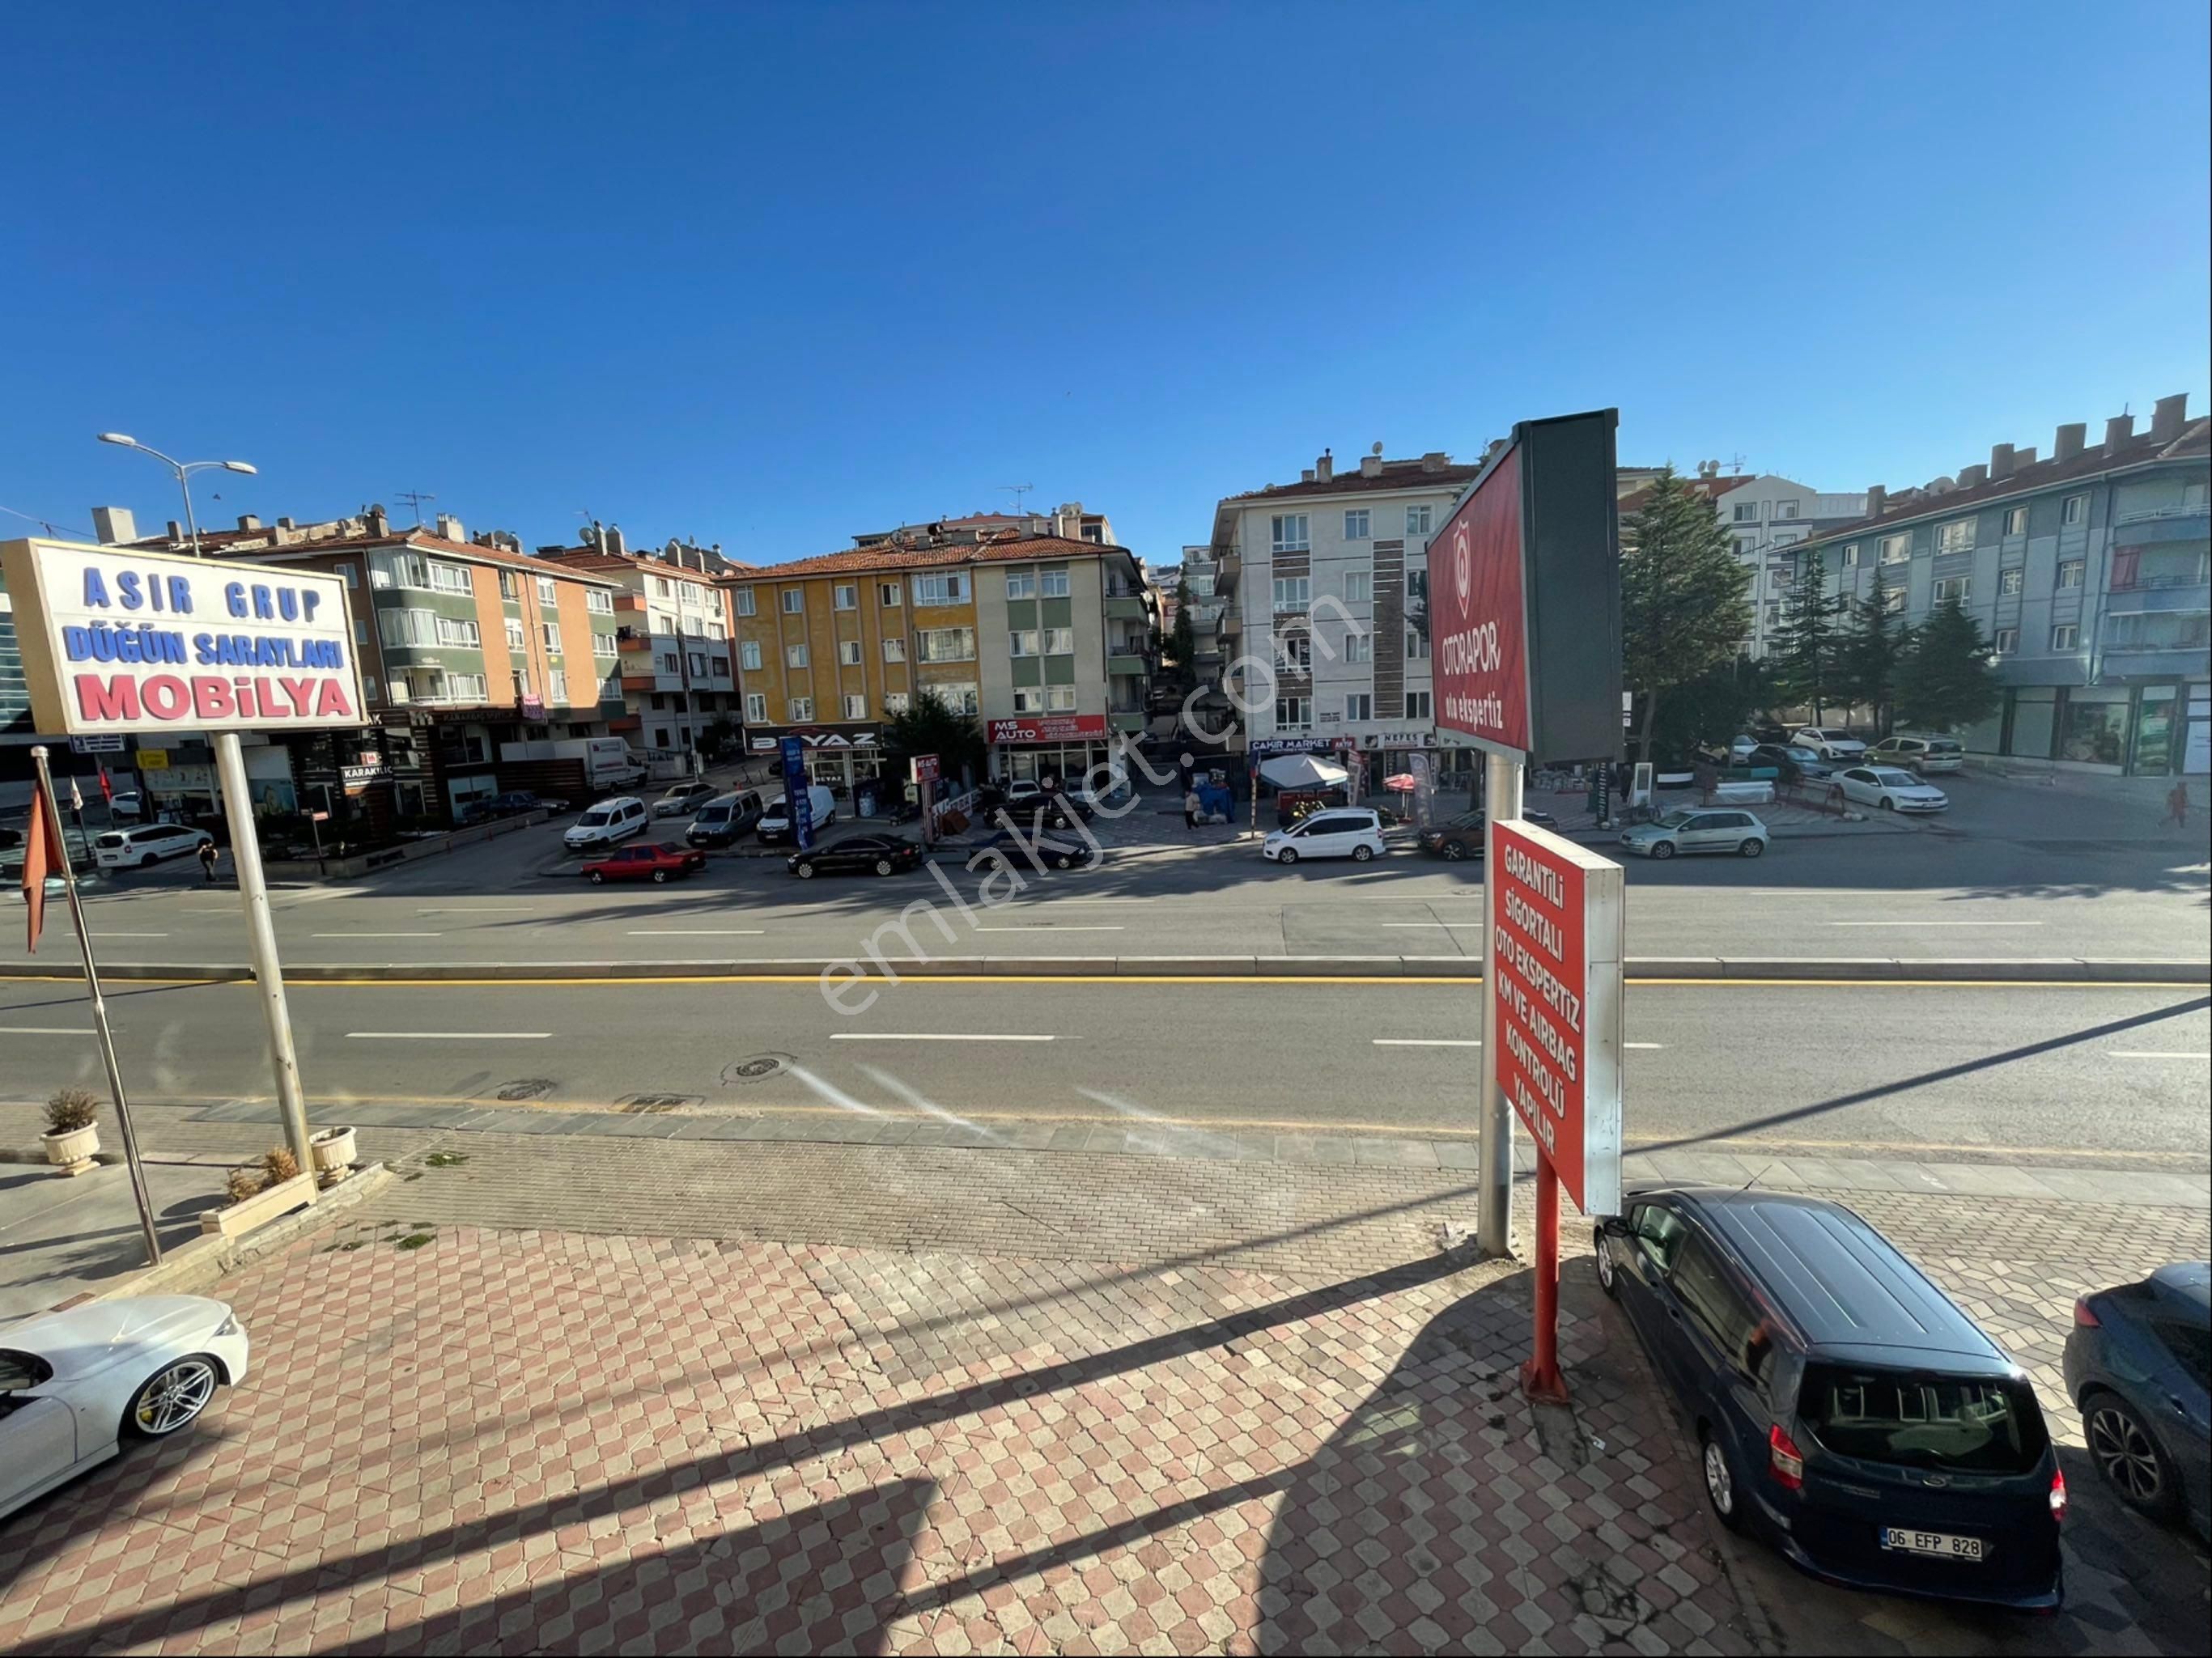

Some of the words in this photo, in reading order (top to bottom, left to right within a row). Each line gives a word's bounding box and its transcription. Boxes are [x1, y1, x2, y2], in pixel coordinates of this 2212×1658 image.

[83, 567, 193, 613] ASIR
[225, 581, 321, 622] GRUP
[62, 620, 187, 664] DÜĞÜN
[193, 632, 345, 668] SARAYLARI
[1442, 621, 1501, 676] OTORAPOR
[995, 721, 1018, 730] MS
[1458, 691, 1503, 731] ekspertiz
[752, 732, 877, 749] BYAZ
[996, 730, 1037, 740] AUTO
[1286, 739, 1331, 748] MARKET
[1496, 925, 1514, 963] OTO
[1498, 969, 1512, 1006] KM
[1514, 984, 1527, 1024] VE
[1530, 1004, 1576, 1082] AIRBAG
[1506, 1019, 1564, 1118] KONTROLÜ
[1514, 1071, 1555, 1156] YAPILIR
[1888, 1530, 1905, 1545] 06
[1915, 1533, 1941, 1550] EFP
[1952, 1538, 1980, 1554] 828
